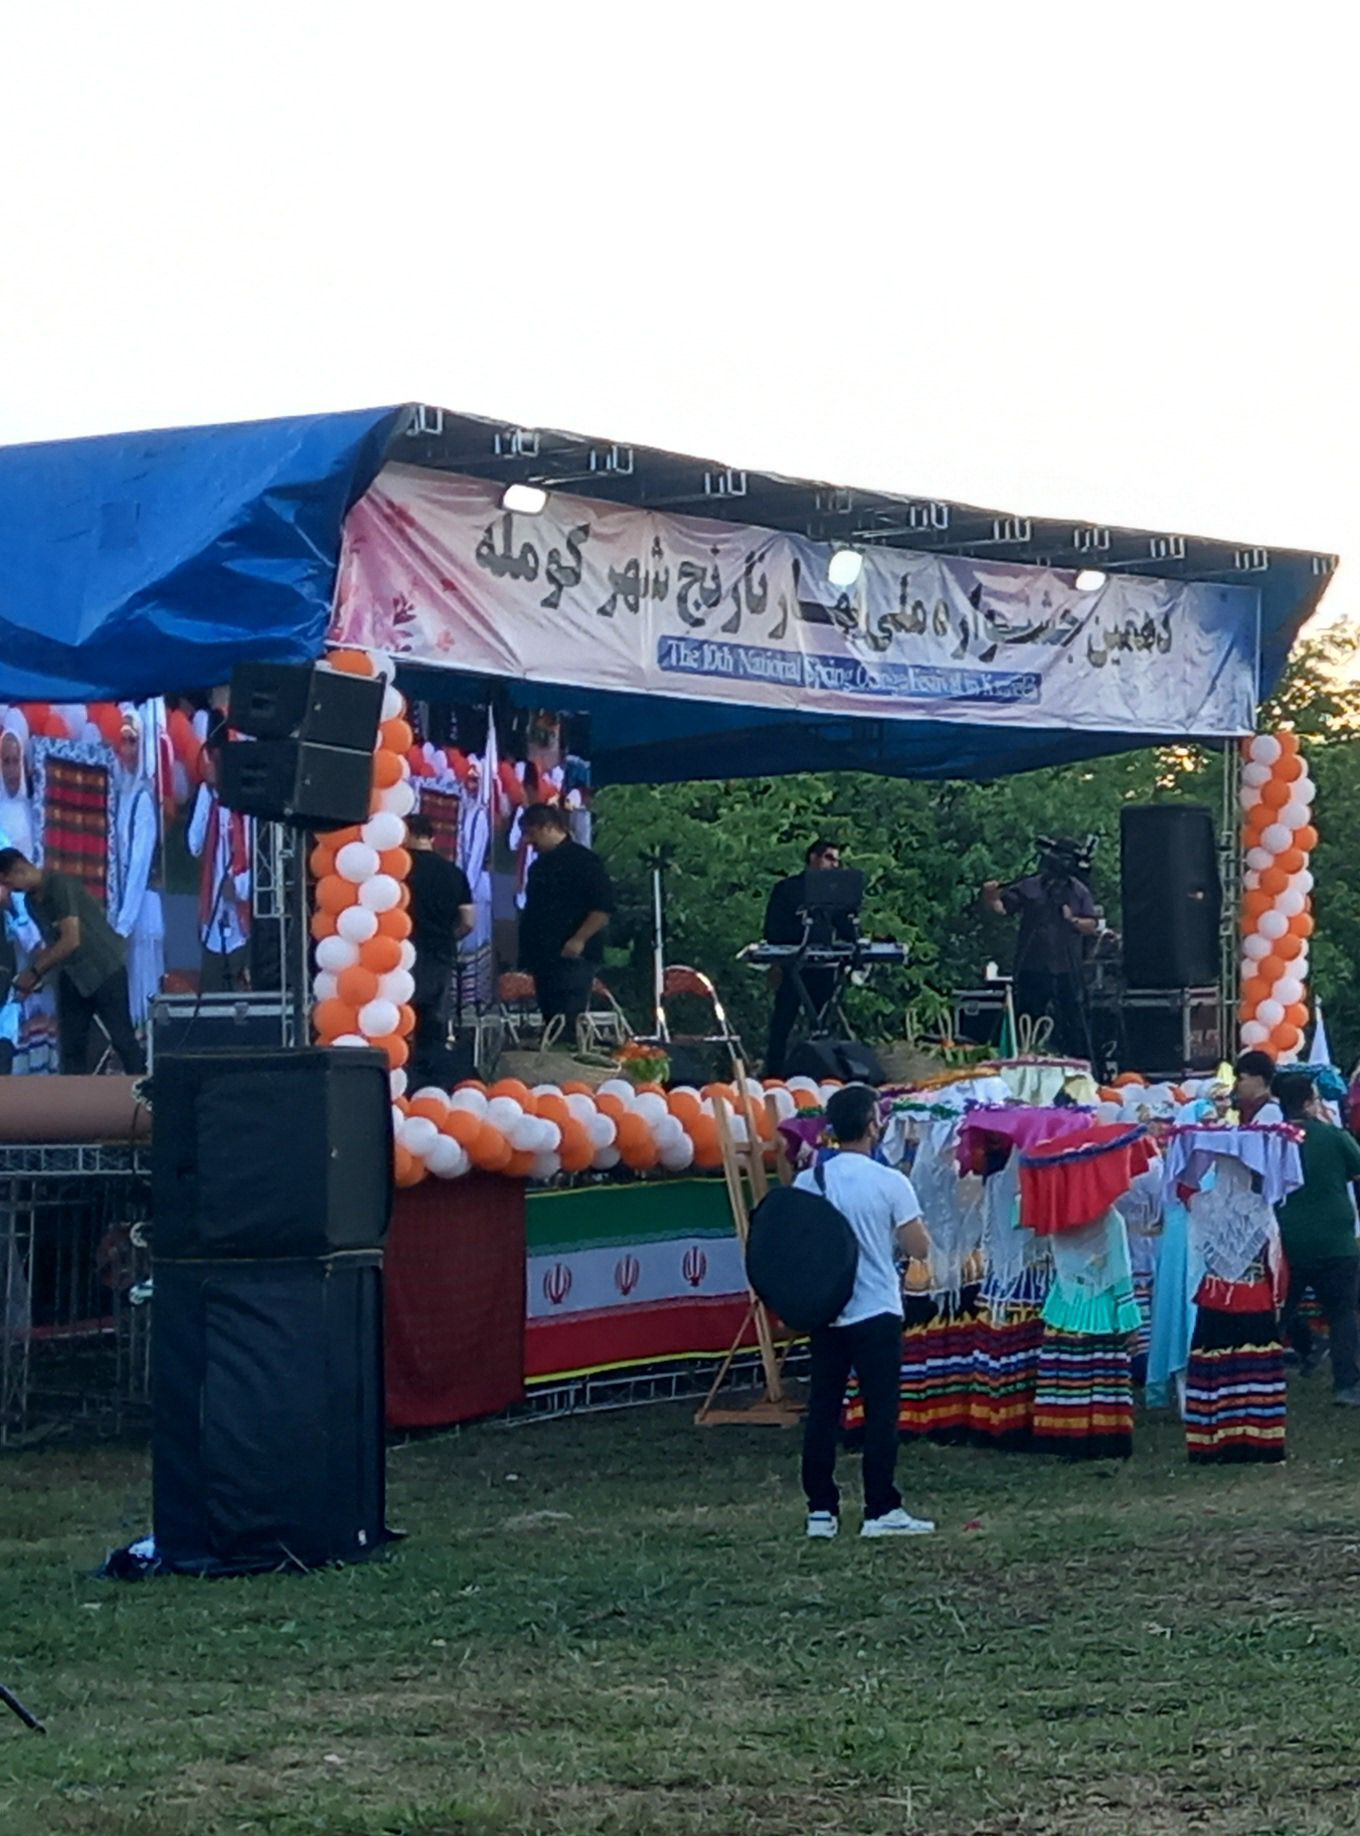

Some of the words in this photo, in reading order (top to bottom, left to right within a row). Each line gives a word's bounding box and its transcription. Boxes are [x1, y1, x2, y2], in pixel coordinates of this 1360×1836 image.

[597, 534, 670, 618] شهر
[676, 544, 768, 634] نارنج
[864, 572, 927, 652] ملی
[667, 639, 698, 669] The
[702, 643, 734, 674] 10th
[738, 648, 801, 684] National
